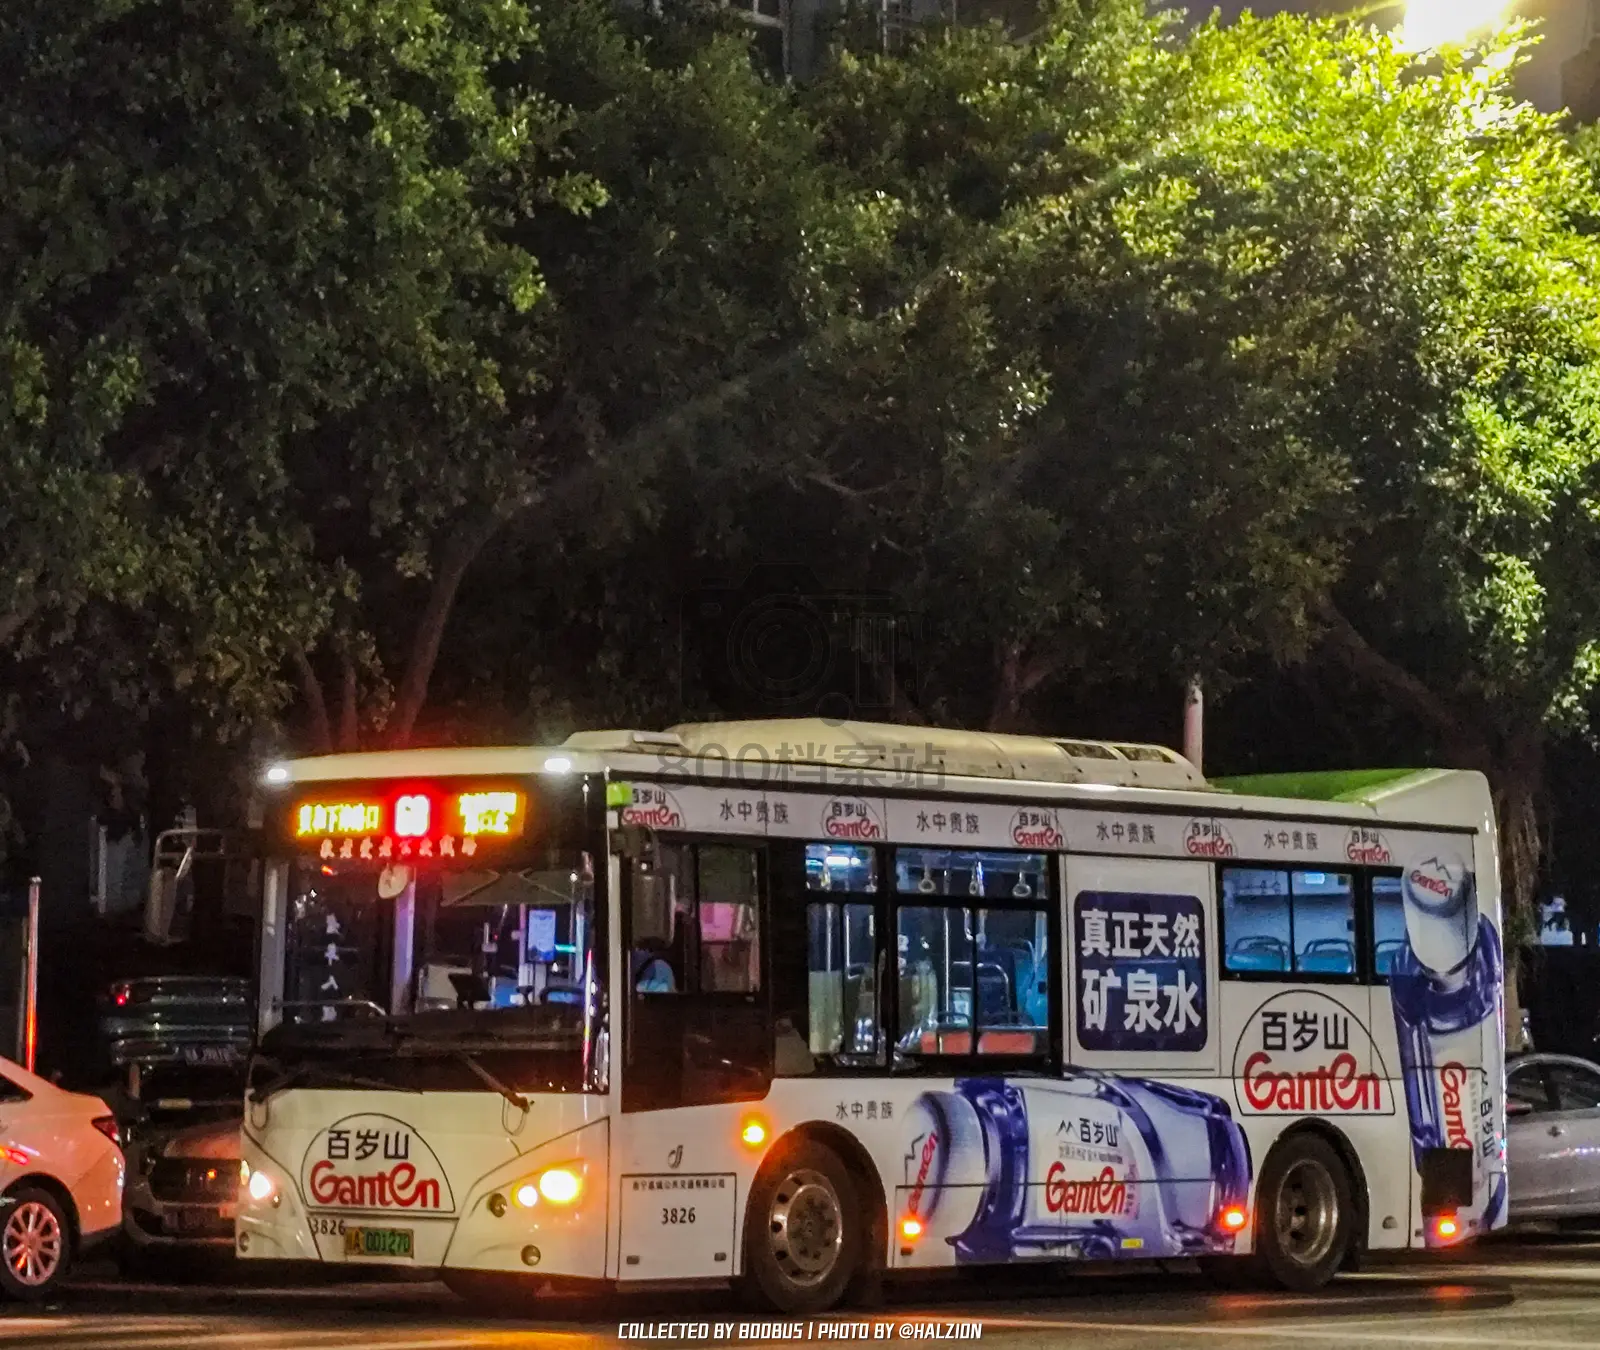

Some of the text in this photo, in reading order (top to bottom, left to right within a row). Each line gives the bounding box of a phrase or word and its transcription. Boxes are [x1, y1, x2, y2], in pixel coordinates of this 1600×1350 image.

[720, 798, 789, 825] 水中贵族
[832, 801, 867, 817] 百岁山
[916, 810, 980, 834] 水中贵族
[1096, 821, 1157, 845] 水中贵族
[1263, 829, 1319, 851] 水中贵族
[1080, 907, 1200, 958] 真正天然
[1081, 968, 1201, 1034] 矿泉水
[1261, 1011, 1349, 1052] 百岁山
[835, 1101, 893, 1119] 水中贵族
[1079, 1117, 1119, 1147] 百岁山
[327, 1129, 409, 1161] 百岁山
[312, 1218, 346, 1237] 3826
[661, 1207, 696, 1225] 3826
